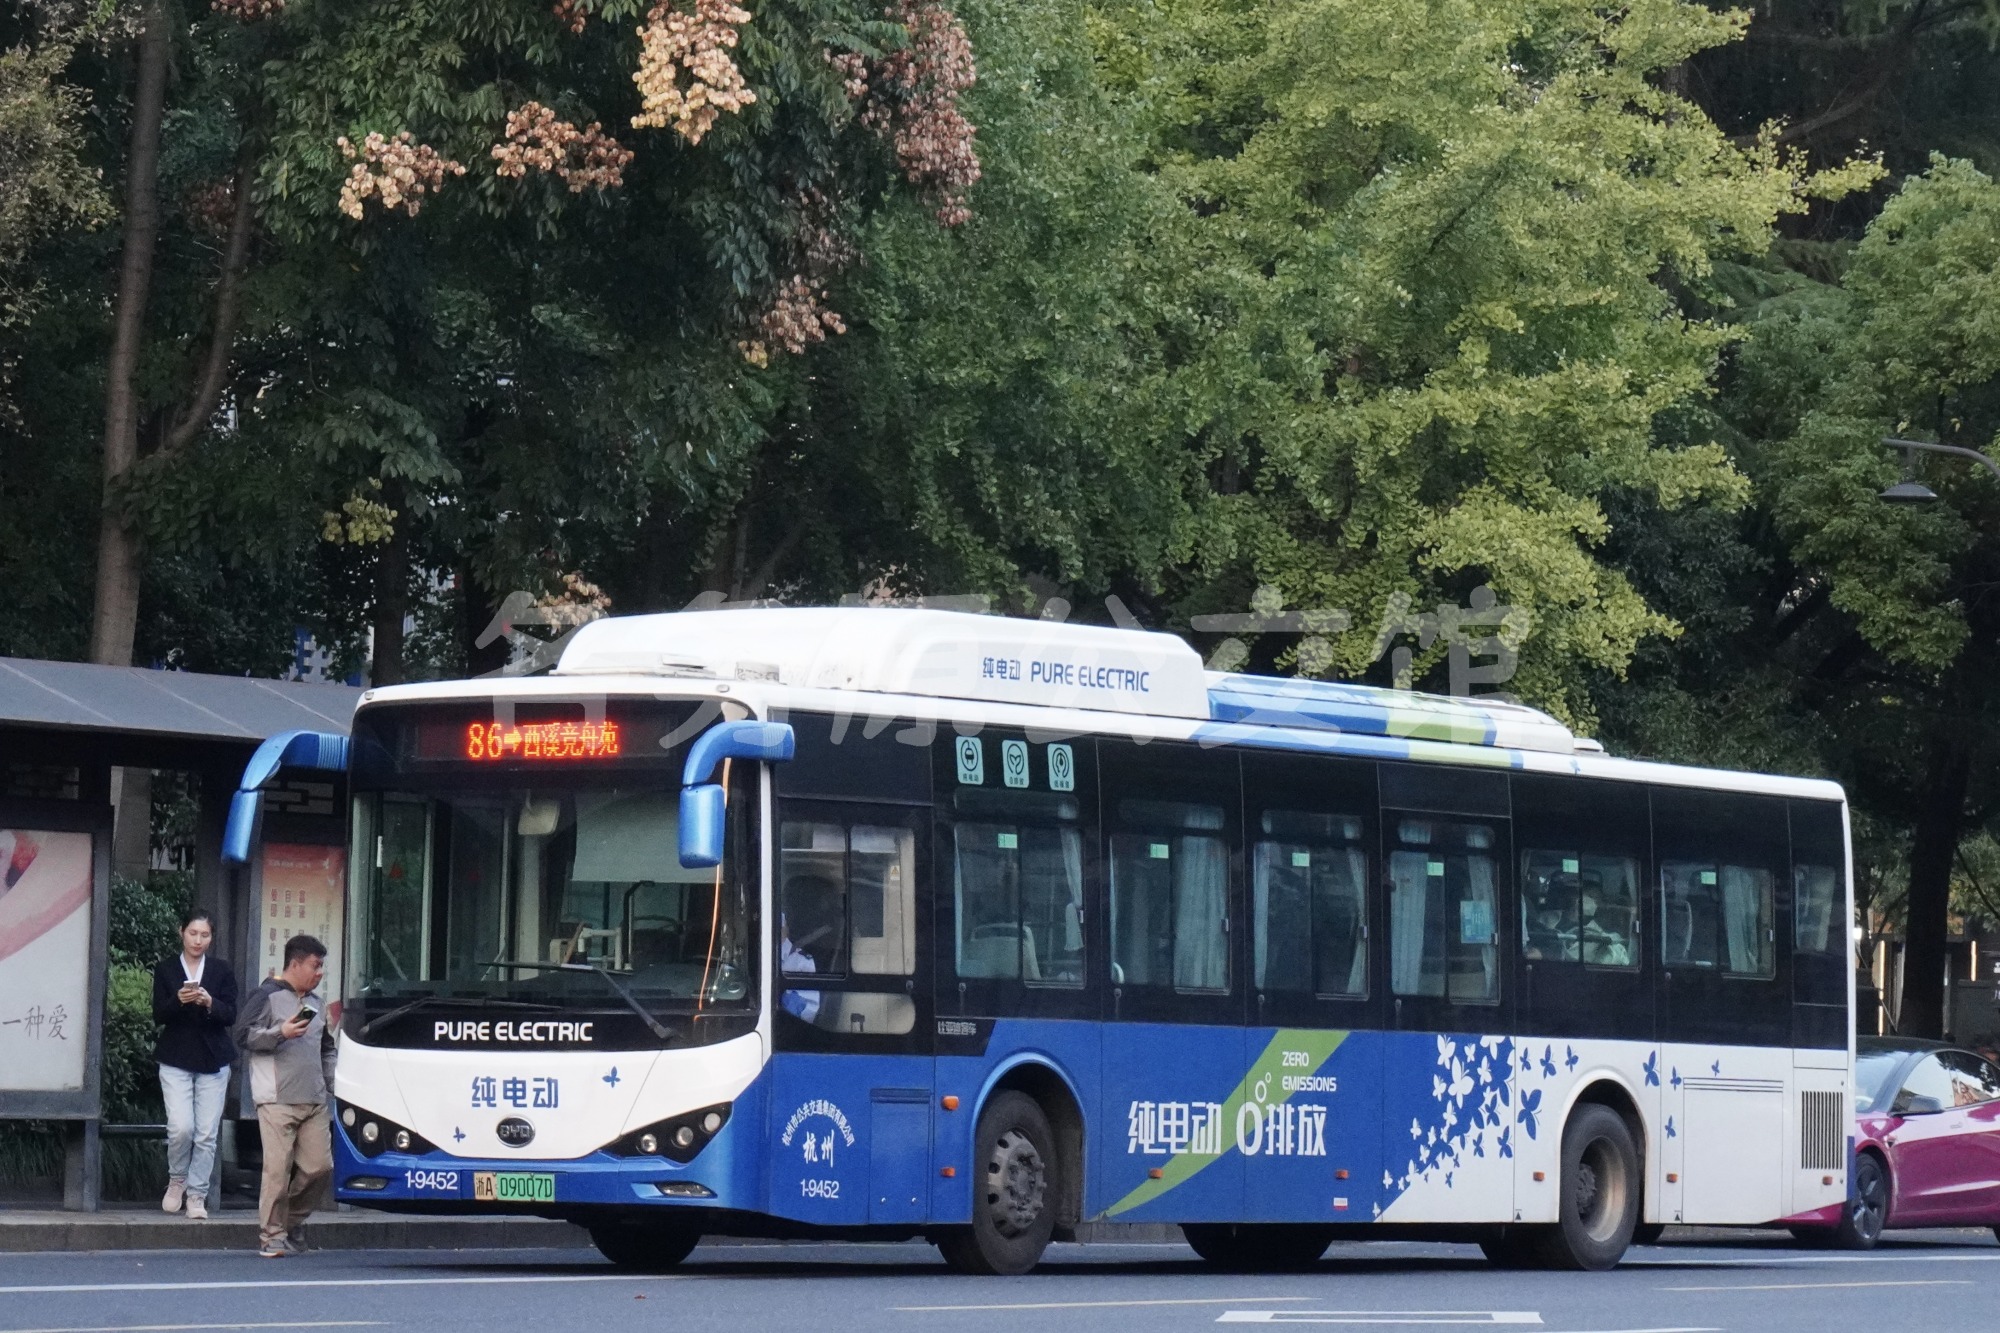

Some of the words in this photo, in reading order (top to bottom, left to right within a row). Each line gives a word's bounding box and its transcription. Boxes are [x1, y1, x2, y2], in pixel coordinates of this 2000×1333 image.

[982, 657, 1021, 681] 纯电动
[1030, 661, 1074, 686] PURE
[1078, 665, 1150, 693] ELECTRIC
[468, 722, 503, 759] 86
[522, 720, 619, 758] 西溪竞舟苑
[2, 1004, 68, 1040] 一种爱
[434, 1021, 490, 1041] PURE
[494, 1021, 594, 1042] ELECTRIC
[1281, 1051, 1310, 1068] ZERO
[471, 1076, 559, 1109] 纯电动
[1281, 1075, 1337, 1093] EMISSIONS
[499, 1124, 531, 1139] BYD
[1127, 1100, 1222, 1155] 纯电动
[1235, 1101, 1328, 1157] 0排放
[802, 1128, 835, 1169] 杭州
[404, 1170, 459, 1191] 1-9452
[800, 1179, 840, 1199] 1-9452
